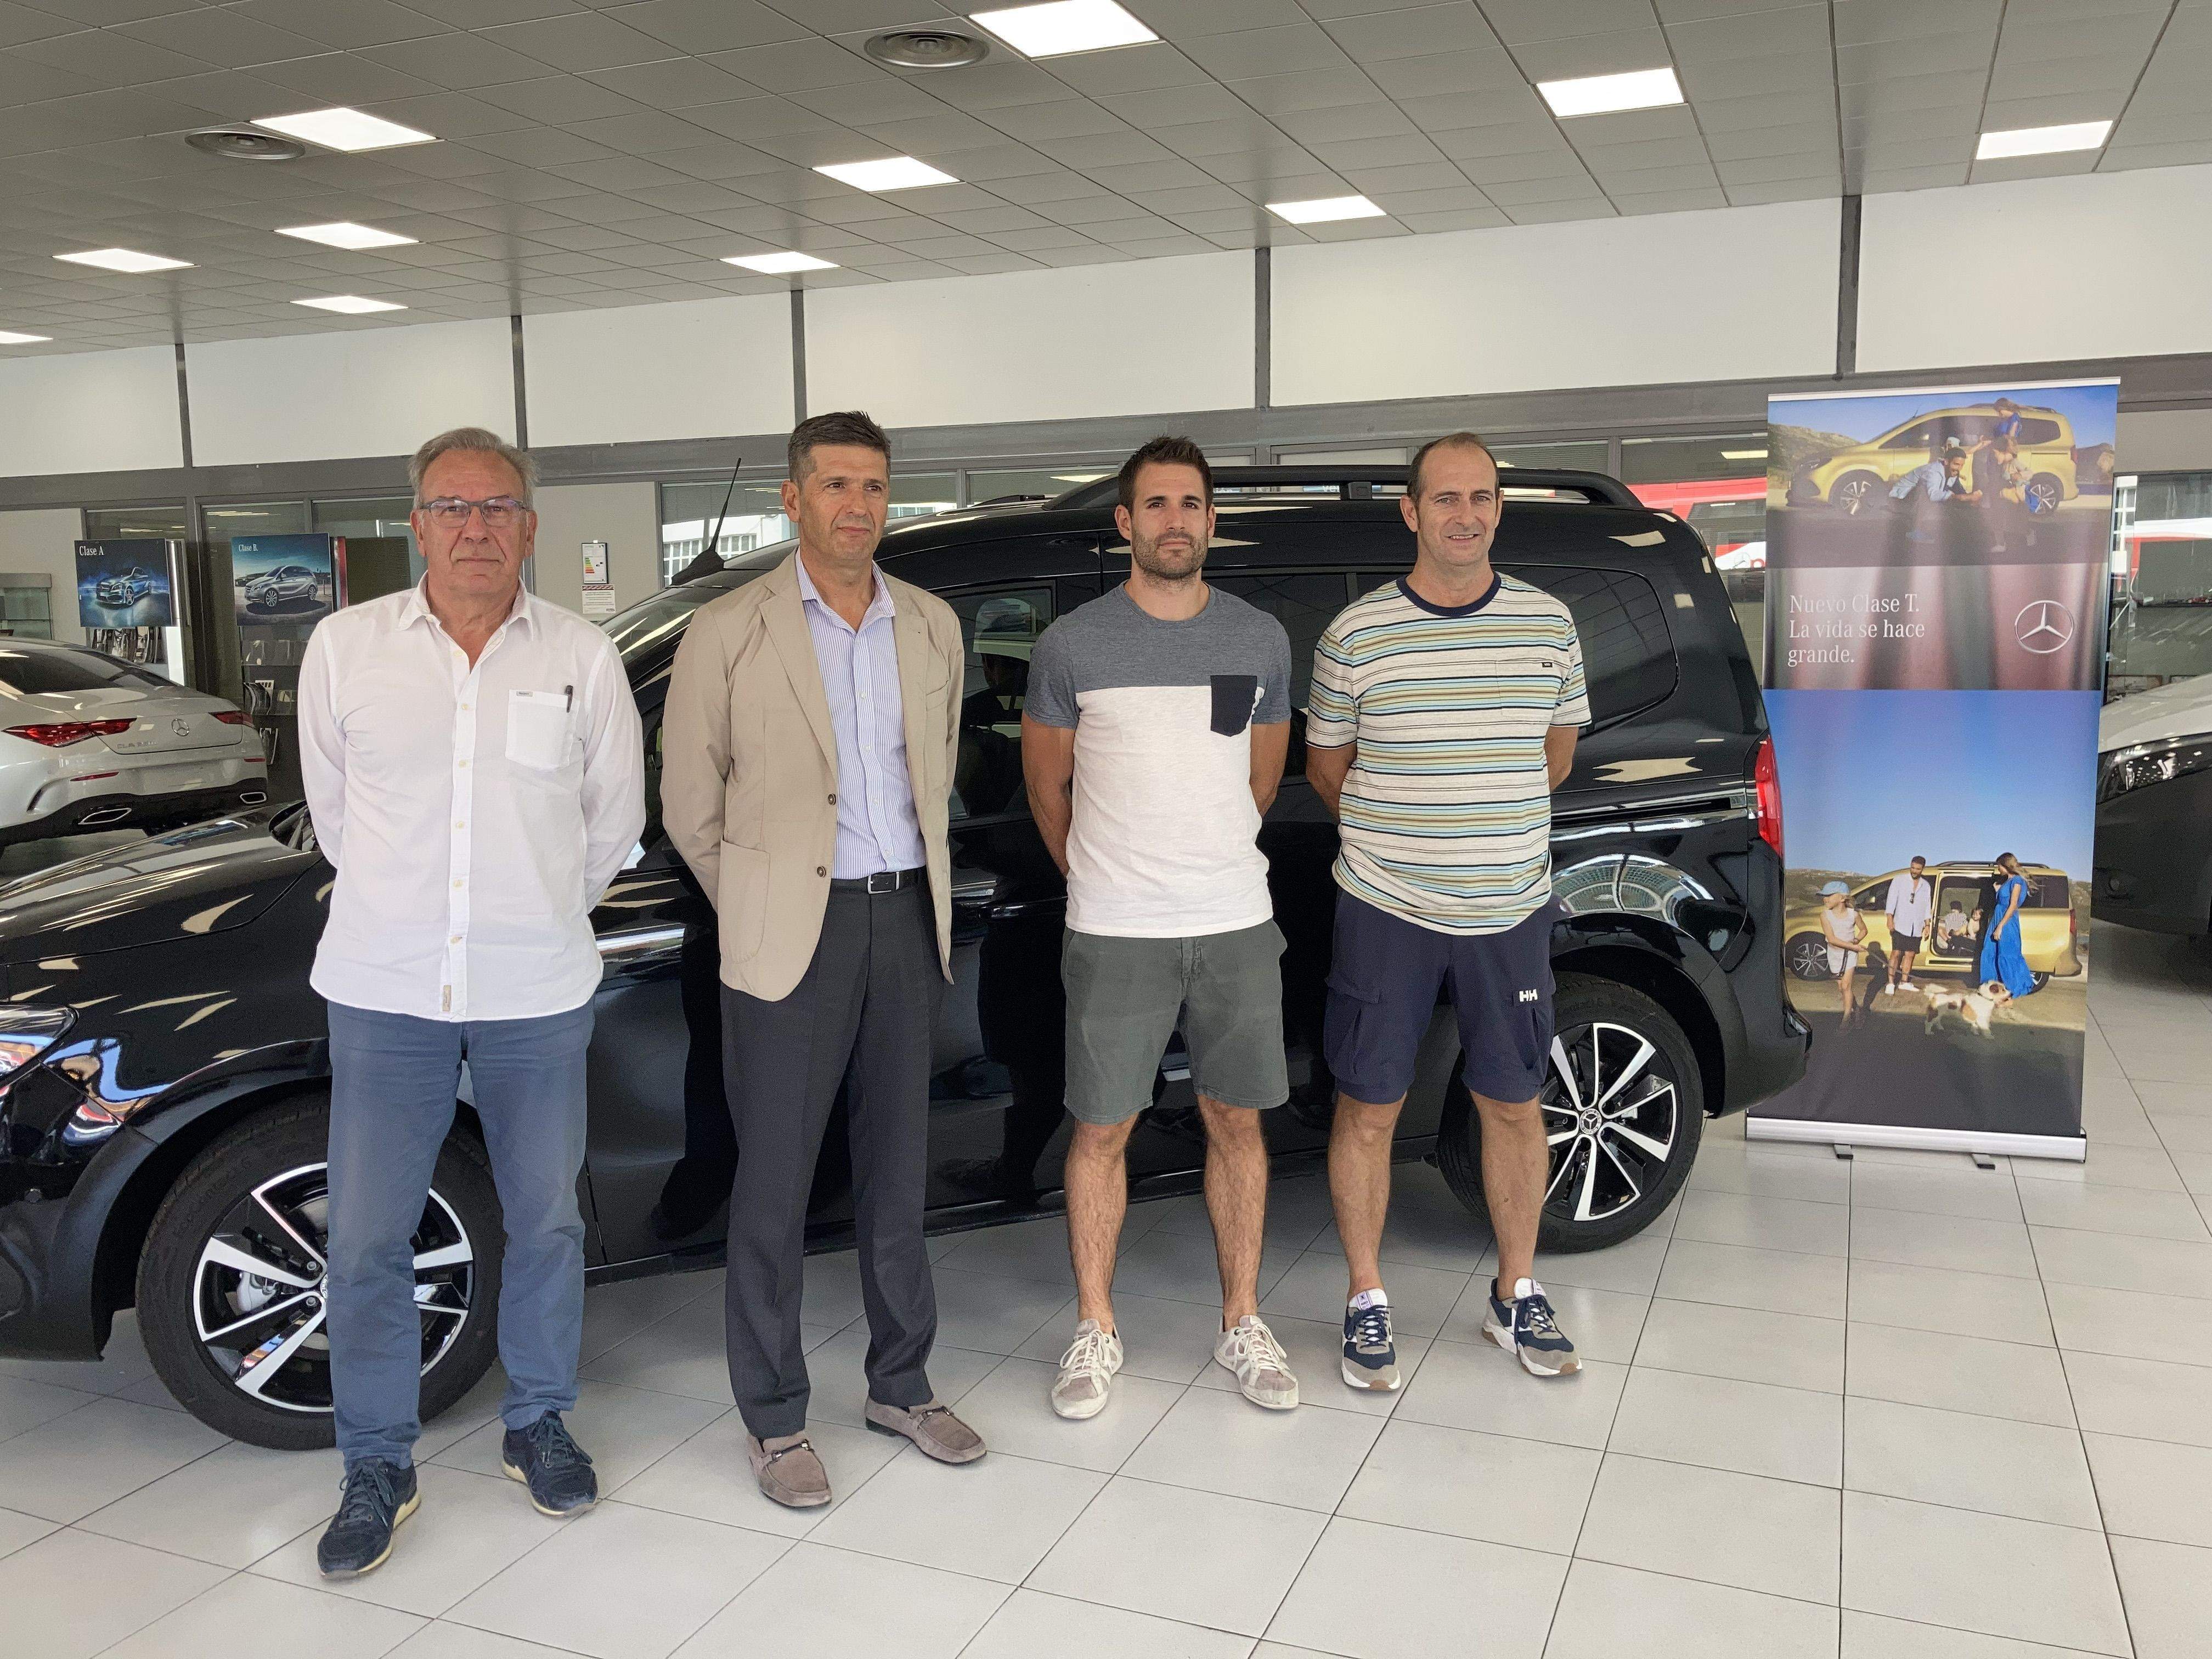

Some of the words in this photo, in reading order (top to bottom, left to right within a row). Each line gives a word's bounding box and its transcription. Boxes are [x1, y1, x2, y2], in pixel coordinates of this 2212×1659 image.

[79, 546, 97, 556] Clase
[99, 545, 104, 556] A
[1790, 595, 1846, 613] Nuevo
[1852, 594, 1900, 613] Clase
[1905, 594, 1920, 612] T.
[1789, 620, 1809, 638] La
[1816, 620, 1852, 637] vida
[1859, 624, 1877, 637] se
[1883, 619, 1925, 637] hace
[1787, 645, 1855, 667] grande.
[1519, 989, 1538, 1002] HH
